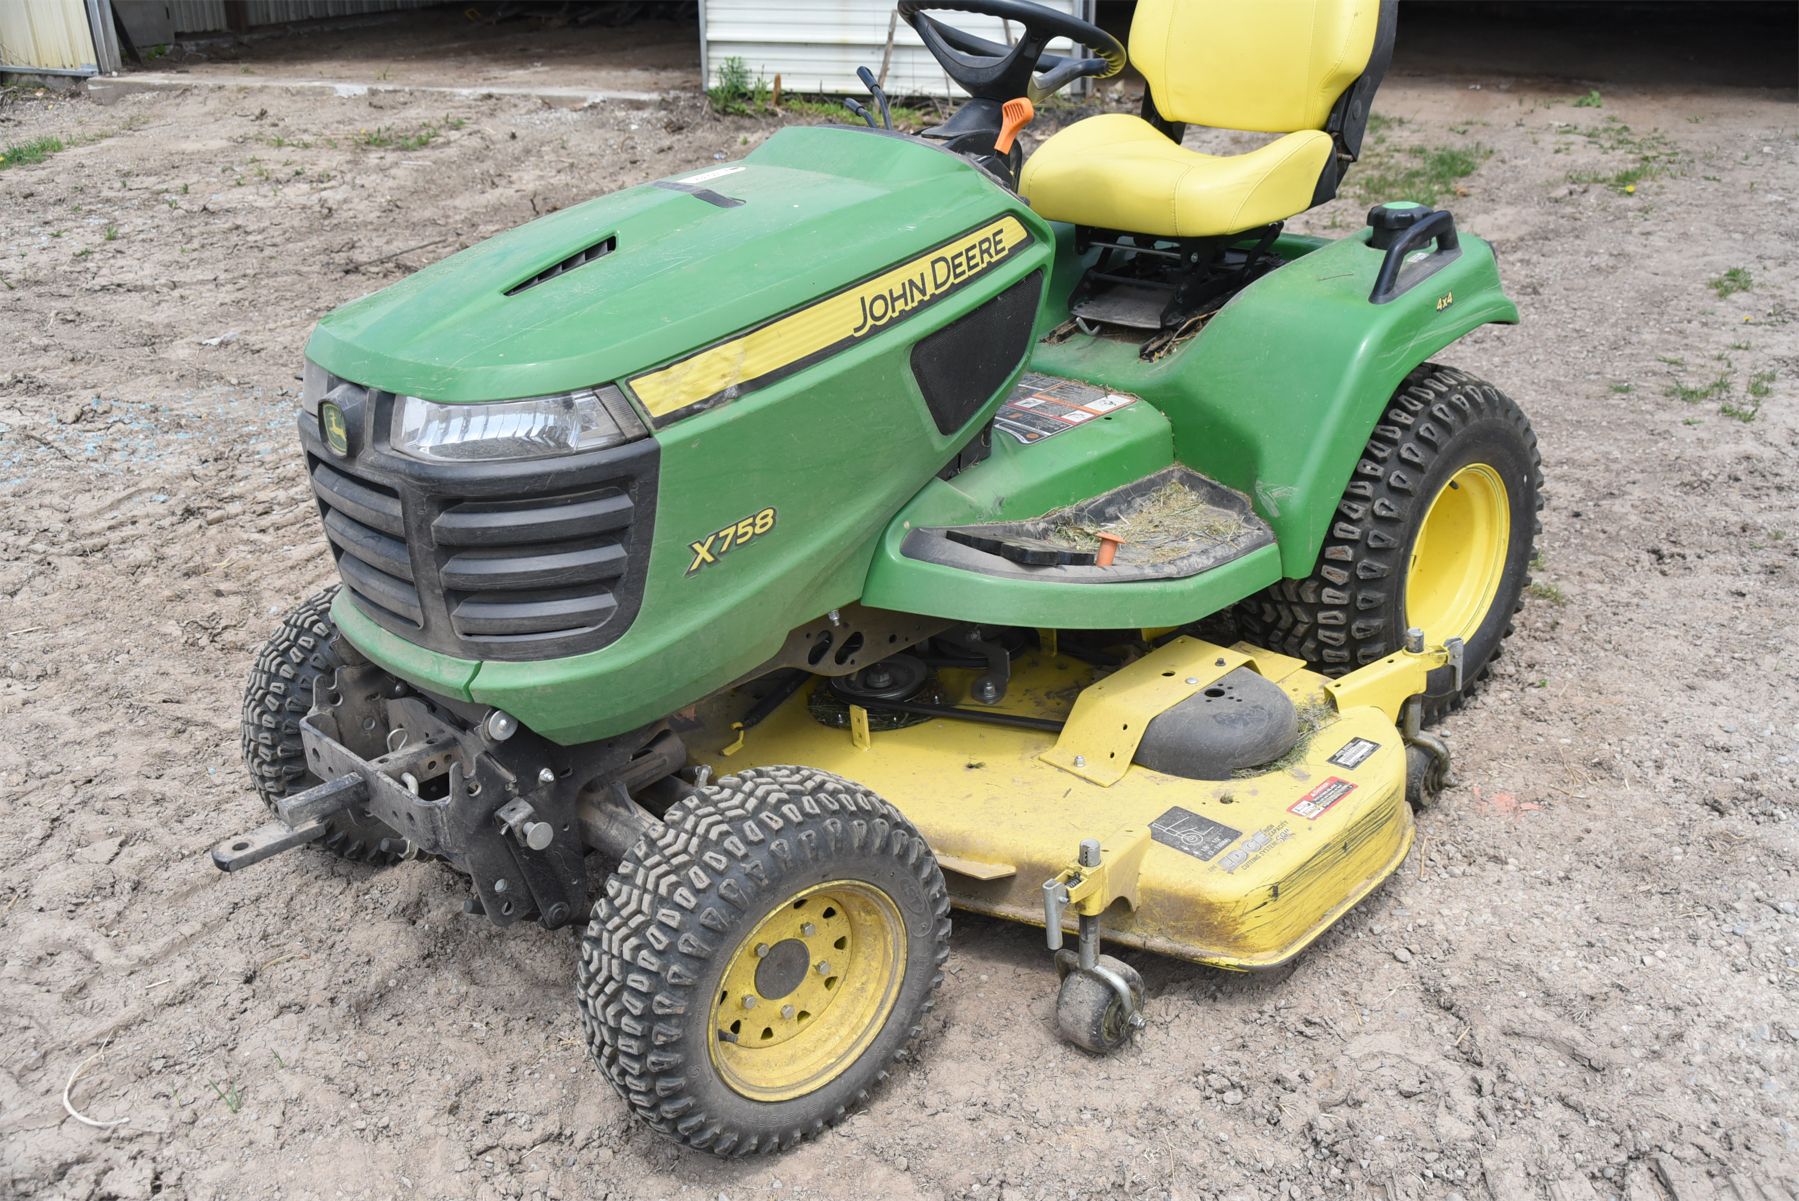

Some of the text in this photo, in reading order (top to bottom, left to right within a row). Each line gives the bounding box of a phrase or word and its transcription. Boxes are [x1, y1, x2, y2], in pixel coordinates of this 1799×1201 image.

[853, 228, 1007, 334] JOHN DEERE
[1436, 290, 1453, 311] 4x4
[687, 507, 777, 574] X758
[1267, 820, 1289, 837] CAPACITY
[1217, 830, 1270, 873] EDGE
[1241, 854, 1261, 870] CUTTING
[1259, 841, 1278, 855] SYSTEM
